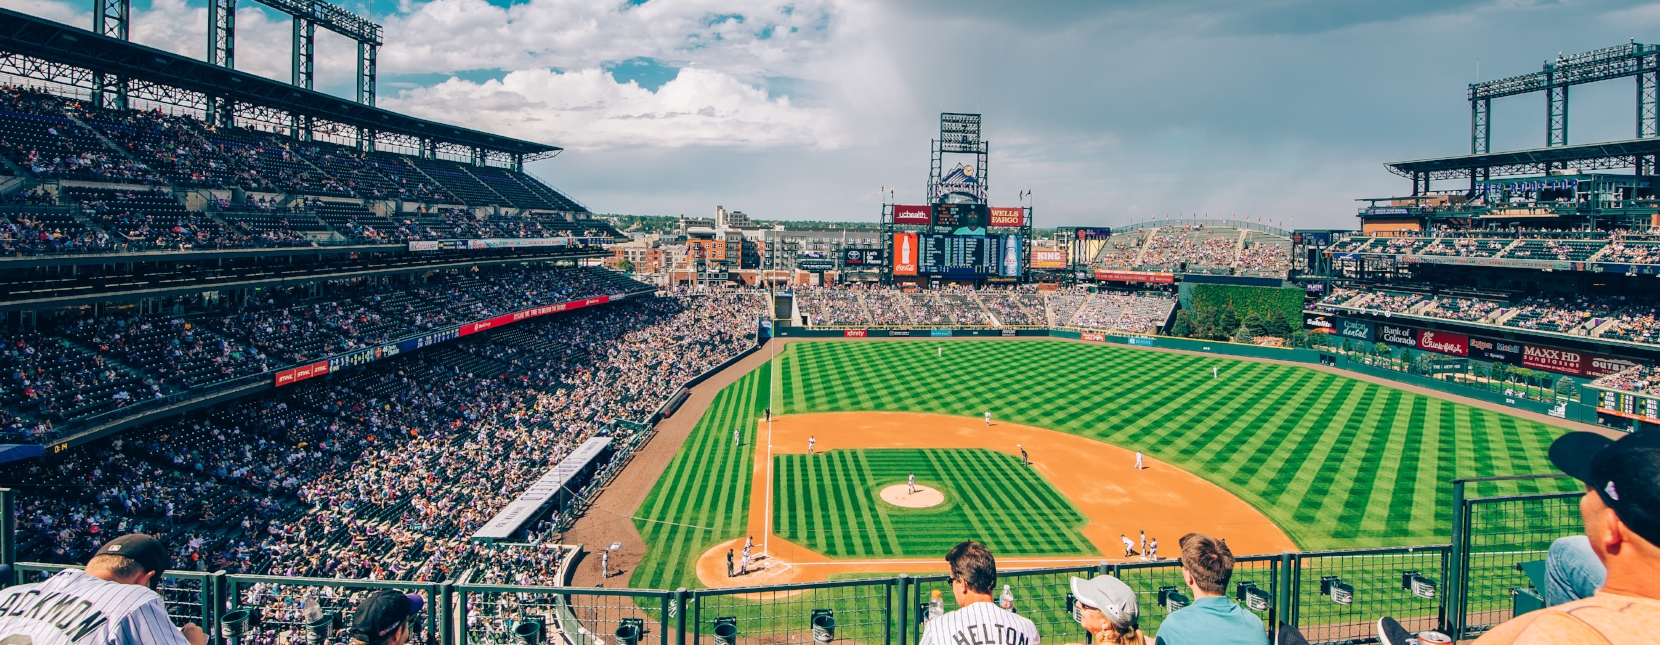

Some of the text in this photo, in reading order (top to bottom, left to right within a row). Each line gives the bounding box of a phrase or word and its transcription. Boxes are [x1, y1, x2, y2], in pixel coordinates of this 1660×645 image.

[1476, 179, 1578, 195] THE ROOFTOP
[1307, 319, 1332, 327] Safelite
[1343, 328, 1368, 338] dental
[1384, 326, 1401, 335] Bank
[1384, 334, 1416, 345] Colorado
[1470, 339, 1492, 350] Exxon
[1497, 343, 1519, 353] Mobil
[1524, 346, 1580, 362] MAXX HD
[1524, 355, 1579, 368] sunglasses
[279, 374, 293, 382] STIHL
[952, 623, 1029, 645] HELTON
